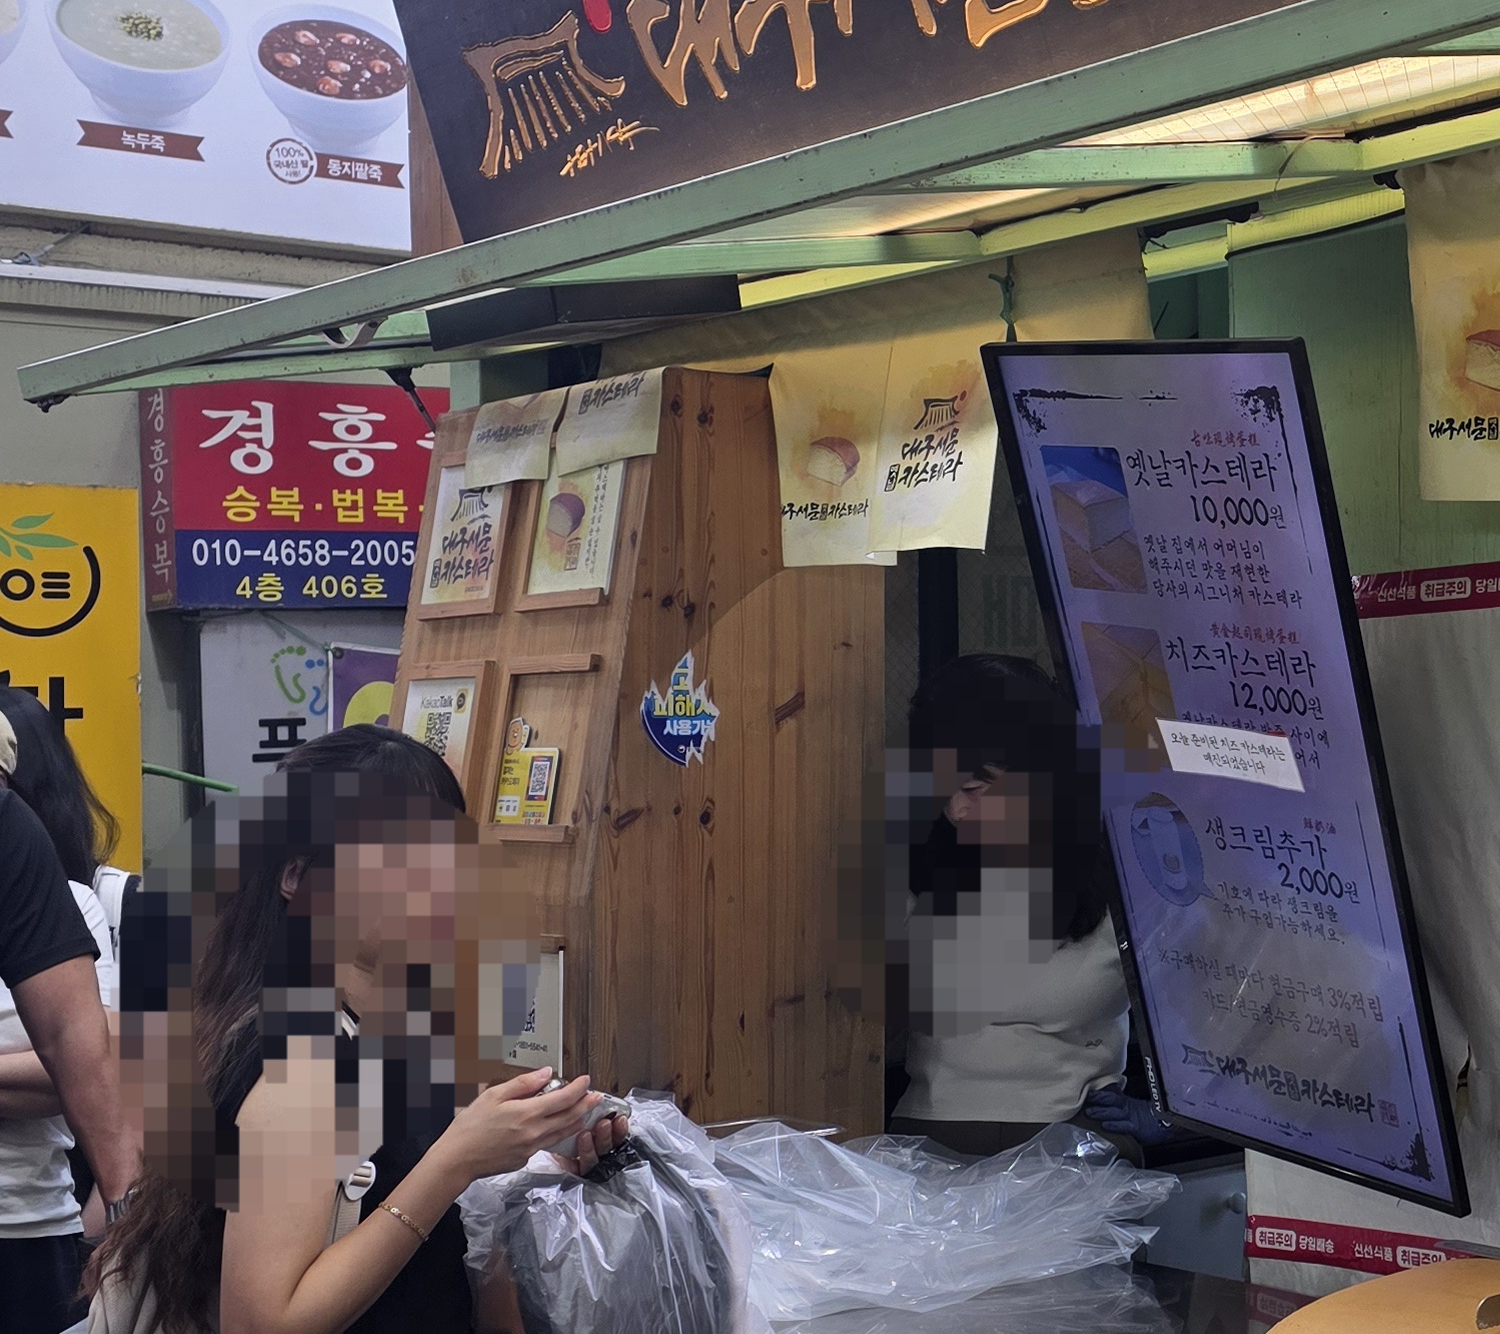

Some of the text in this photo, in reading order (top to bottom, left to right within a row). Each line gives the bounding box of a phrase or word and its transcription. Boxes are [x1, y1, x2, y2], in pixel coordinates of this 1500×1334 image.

[121, 130, 166, 153] 녹두죽
[275, 146, 304, 158] 100%
[901, 427, 960, 461] 대구서문
[1428, 415, 1487, 441] 대구서문
[147, 387, 171, 583] 경흥승복
[898, 450, 964, 488] 카스테라
[1126, 448, 1278, 492] 옛날카스테라
[1190, 494, 1287, 530] 10,000원
[191, 537, 416, 567] 010-4658-2005
[442, 522, 492, 557] 대구서문
[1144, 534, 1266, 561] 옛날 집에서 어머님이
[441, 550, 494, 584] 카스테라
[1201, 560, 1227, 581] 맛을
[1231, 562, 1271, 584] 재현한
[235, 572, 388, 602] 4층 406호
[1153, 578, 1303, 610] 당사의 시그니처 카스테라
[1423, 580, 1469, 599] 취급주의
[1165, 636, 1317, 688] 치즈카스테라
[1229, 681, 1324, 720] 12,000원
[1171, 732, 1286, 762] 오늘 준비된 치즈 카스테라는
[1203, 752, 1266, 775] 매진되었습니다
[1205, 816, 1328, 871] 생크림추가
[1278, 862, 1361, 905] 2,000원
[1217, 881, 1338, 924] 기호에 따라 생크림을
[1216, 1054, 1286, 1097] 대구서문
[1301, 1078, 1375, 1123] 카스테라
[1258, 1229, 1293, 1248] 취급주의
